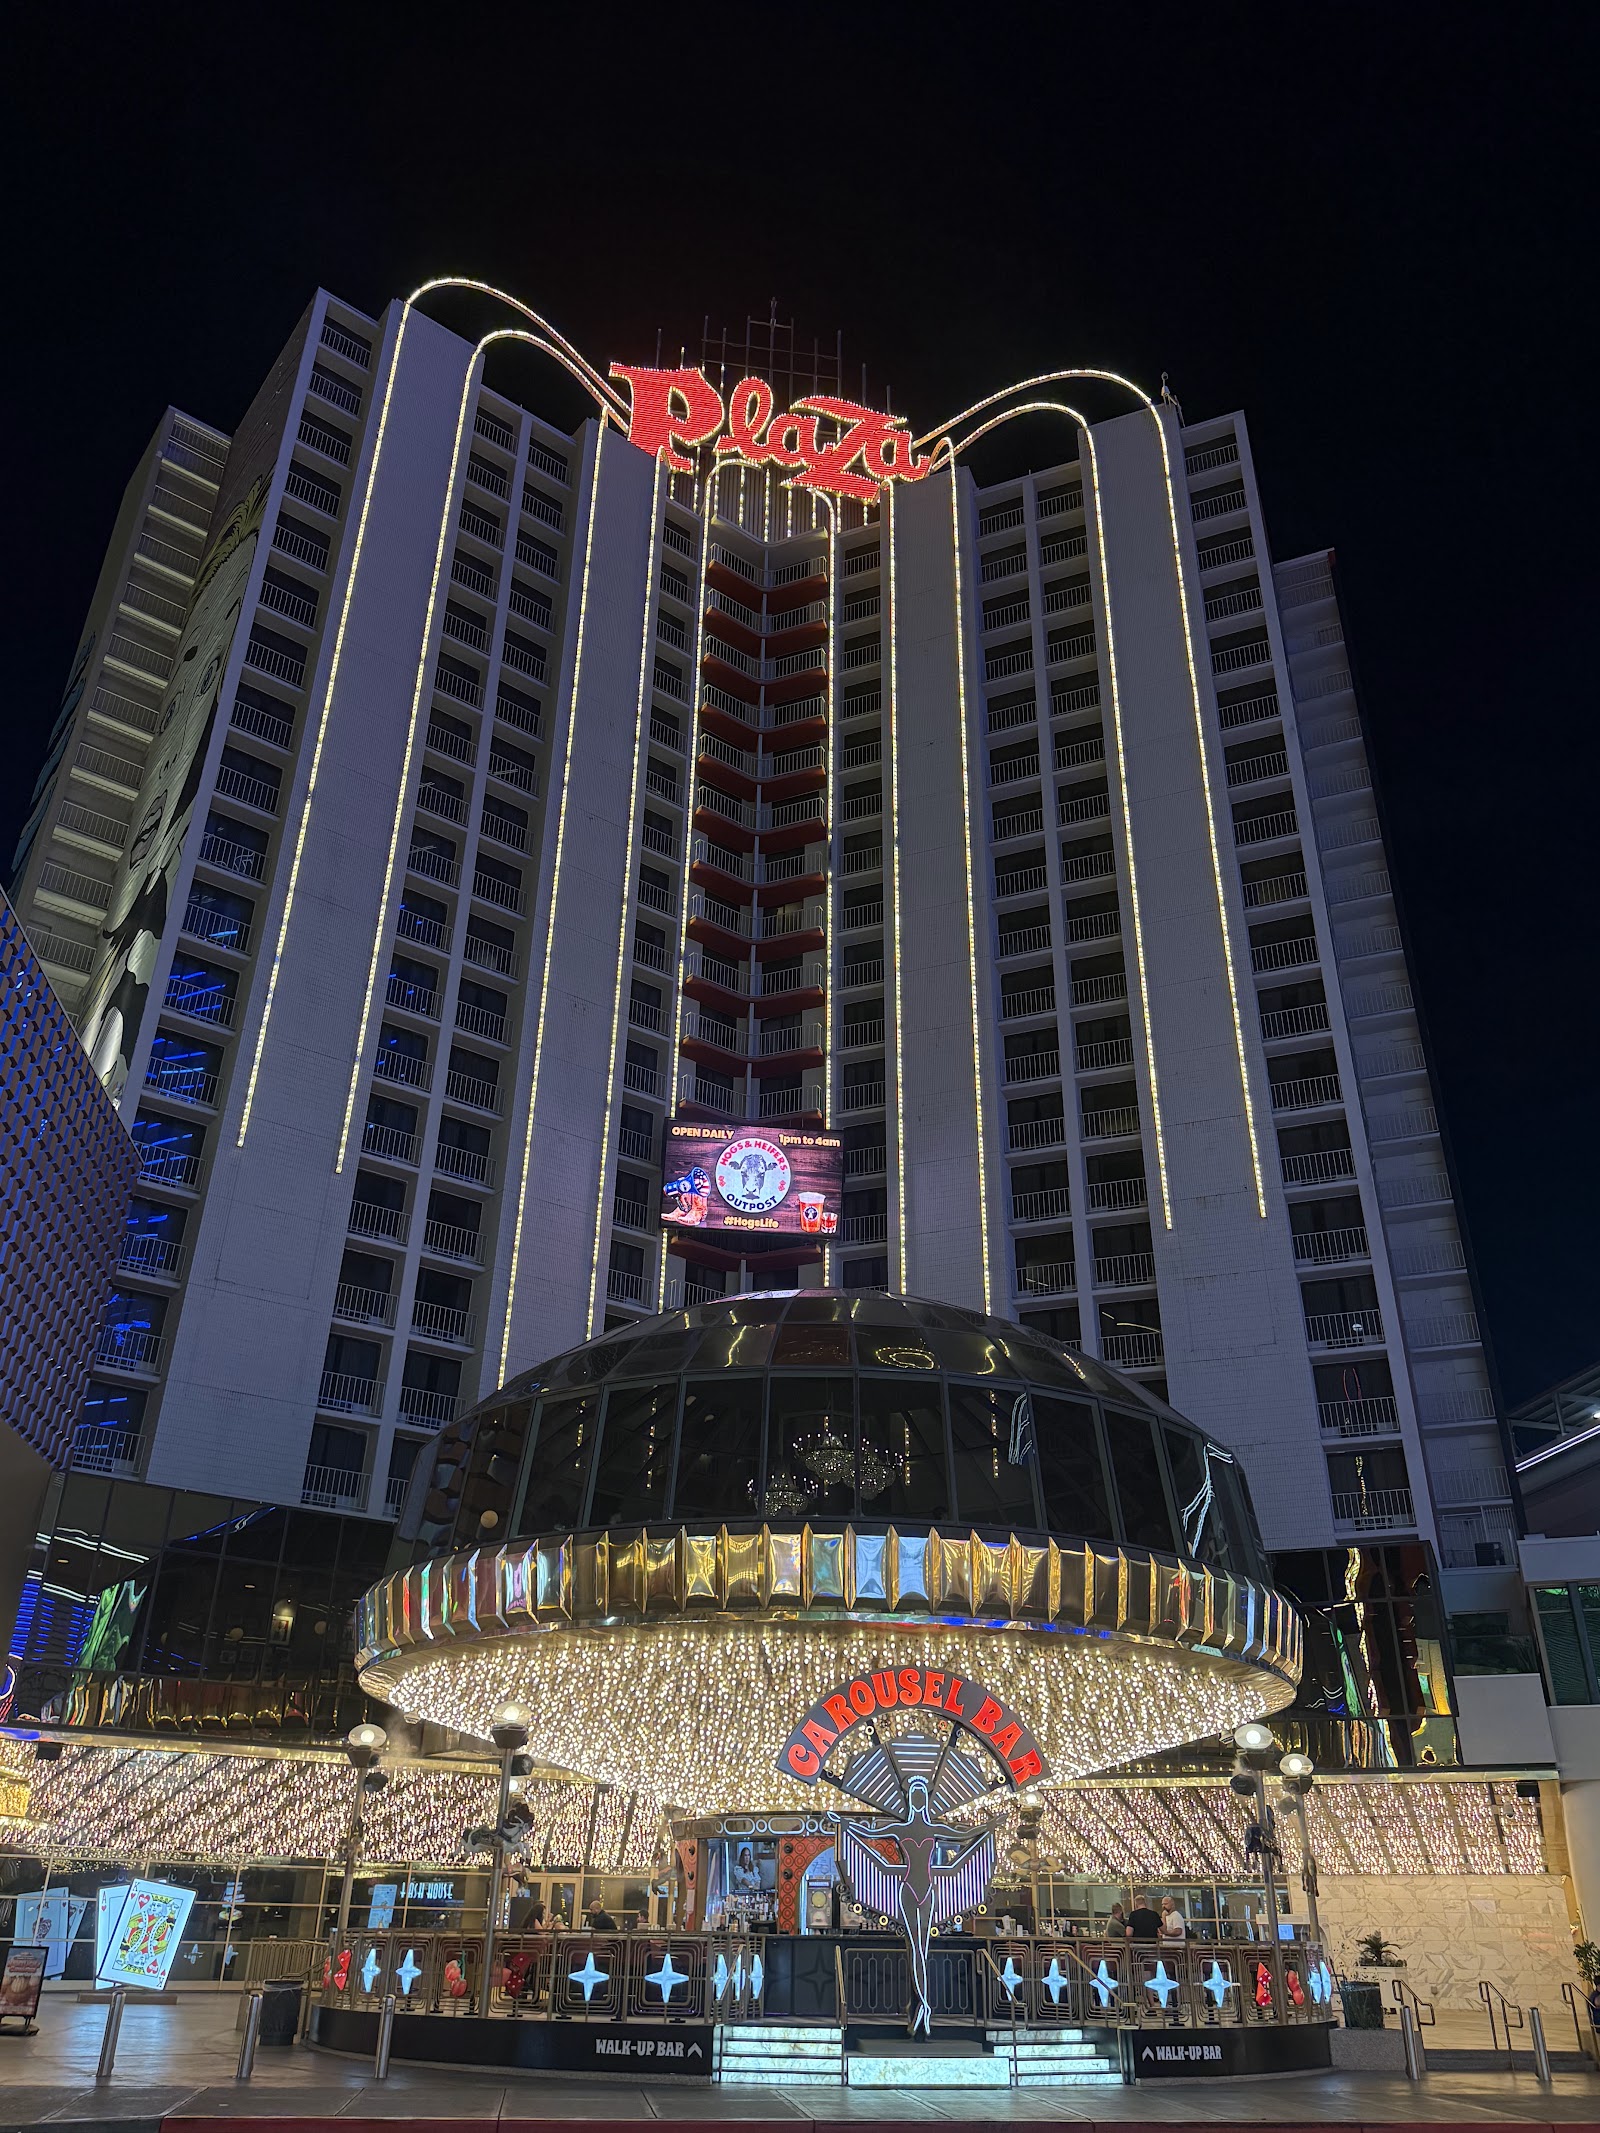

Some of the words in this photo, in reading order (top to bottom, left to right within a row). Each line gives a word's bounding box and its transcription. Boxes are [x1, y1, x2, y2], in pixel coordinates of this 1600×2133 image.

[608, 361, 932, 507] Plaza
[671, 1126, 701, 1138] OPEN
[702, 1129, 735, 1140] DAILY
[778, 1133, 801, 1146] 1pm
[802, 1135, 813, 1146] to
[814, 1136, 841, 1148] 4am
[719, 1142, 744, 1166] HOGS
[744, 1140, 753, 1149] &
[754, 1140, 788, 1171] HEIFERS
[726, 1193, 777, 1211] OUTPOST
[723, 1216, 779, 1230] #HogsLife
[787, 1668, 964, 1778] CAROUSEL
[969, 1695, 1043, 1786] BAR
[133, 1881, 140, 1892] K
[426, 1882, 454, 1900] HOUSE
[101, 1890, 107, 1904] A
[595, 2039, 656, 2057] WALK-UP
[656, 2041, 685, 2058] BAR
[1156, 2046, 1202, 2061] WALK-UP
[1203, 2045, 1222, 2060] BAR
